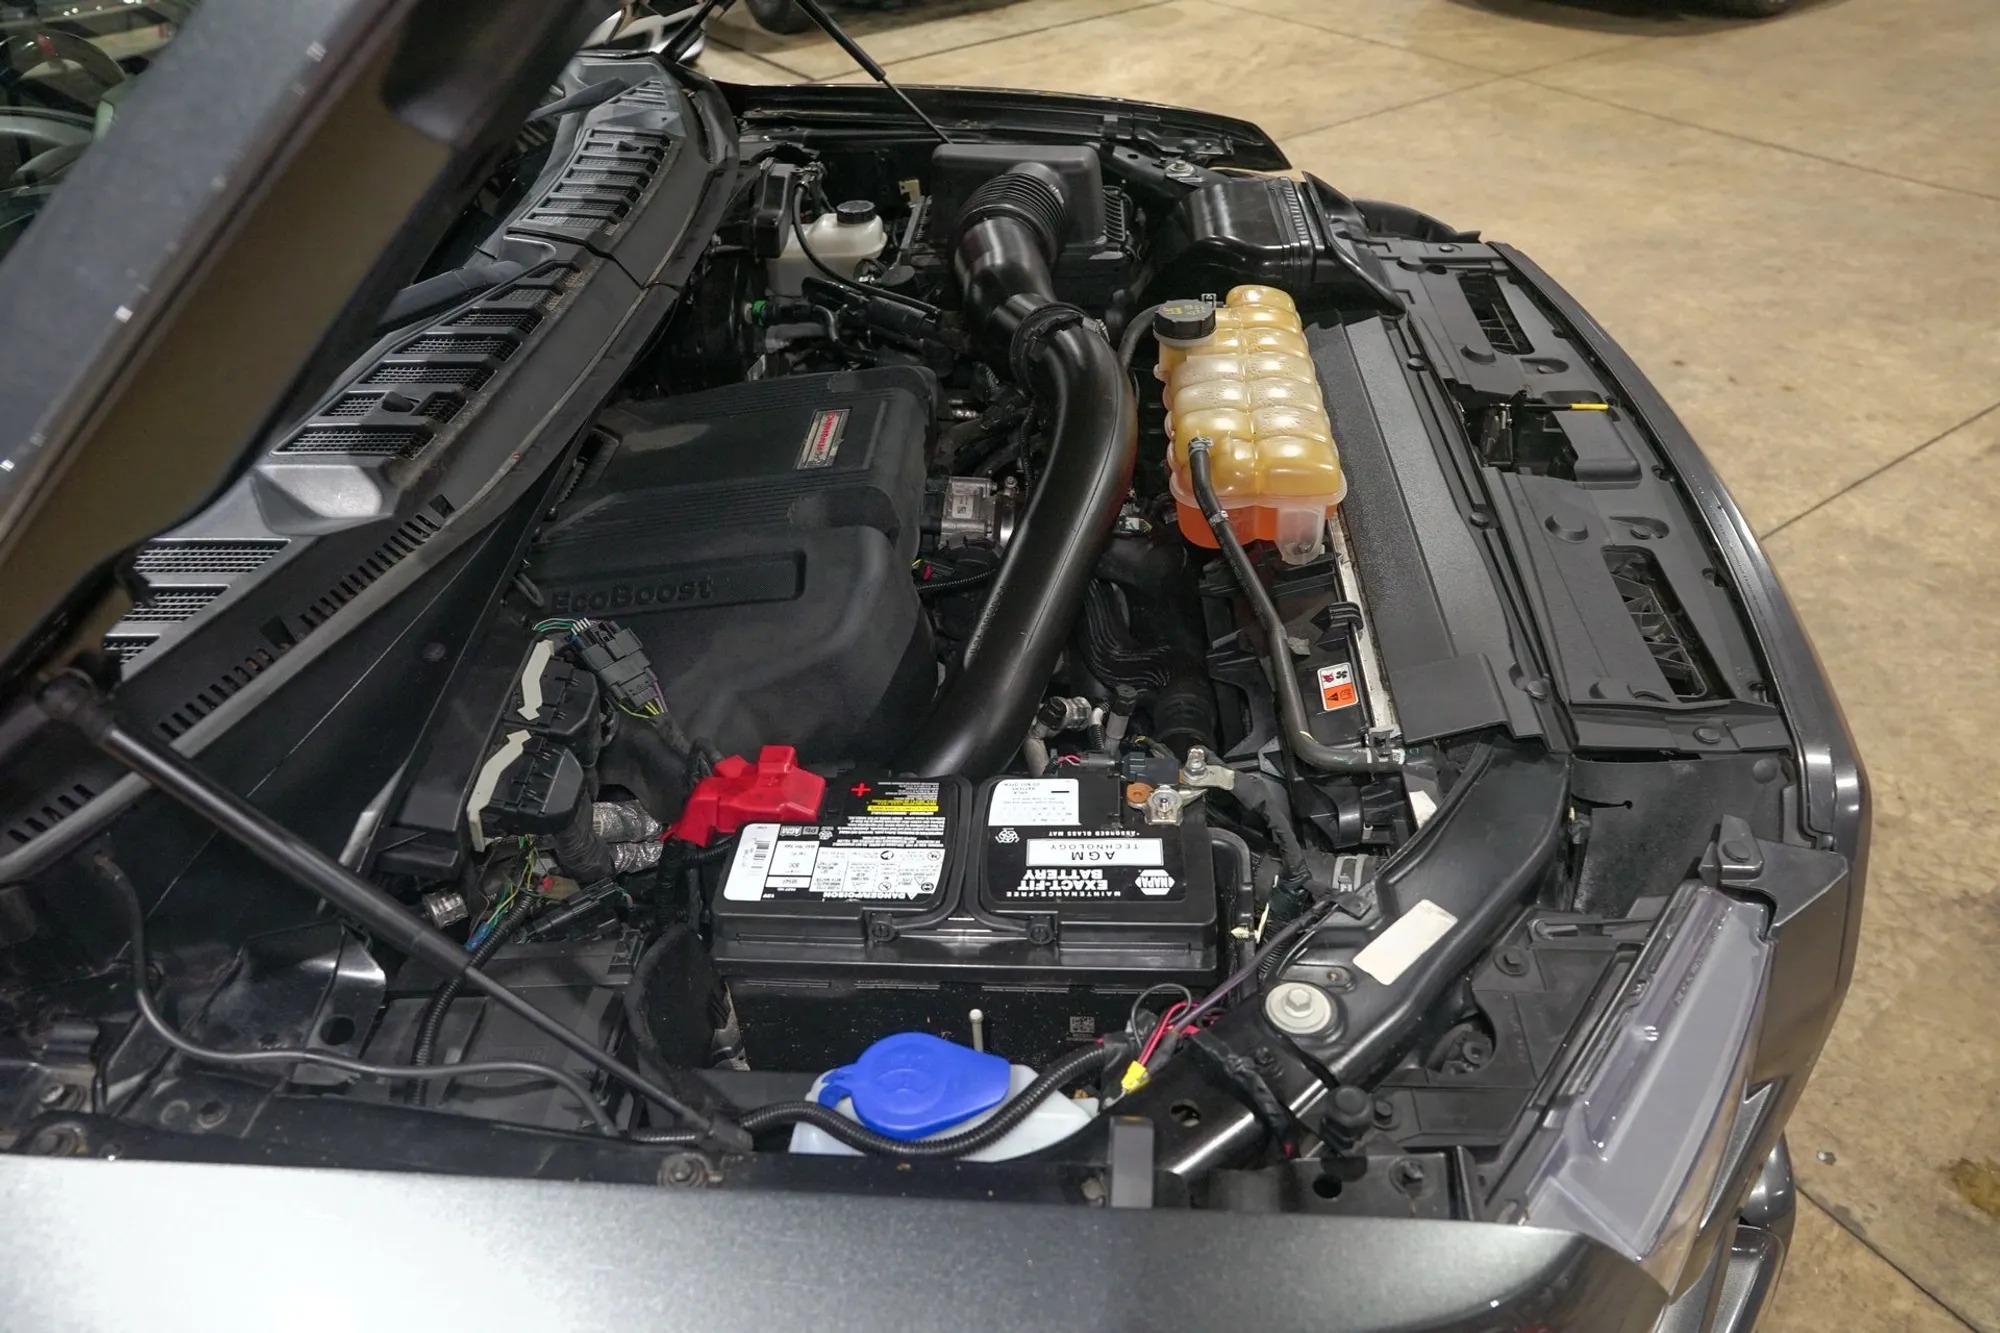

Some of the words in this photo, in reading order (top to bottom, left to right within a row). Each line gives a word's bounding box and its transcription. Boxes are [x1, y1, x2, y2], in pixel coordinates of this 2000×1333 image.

[553, 576, 713, 613] EcoBoost
[1071, 851, 1115, 861] AGM
[1022, 869, 1103, 880] BATTERY
[1017, 879, 1108, 891] EXACT-FIT
[1141, 876, 1168, 888] NAPA
